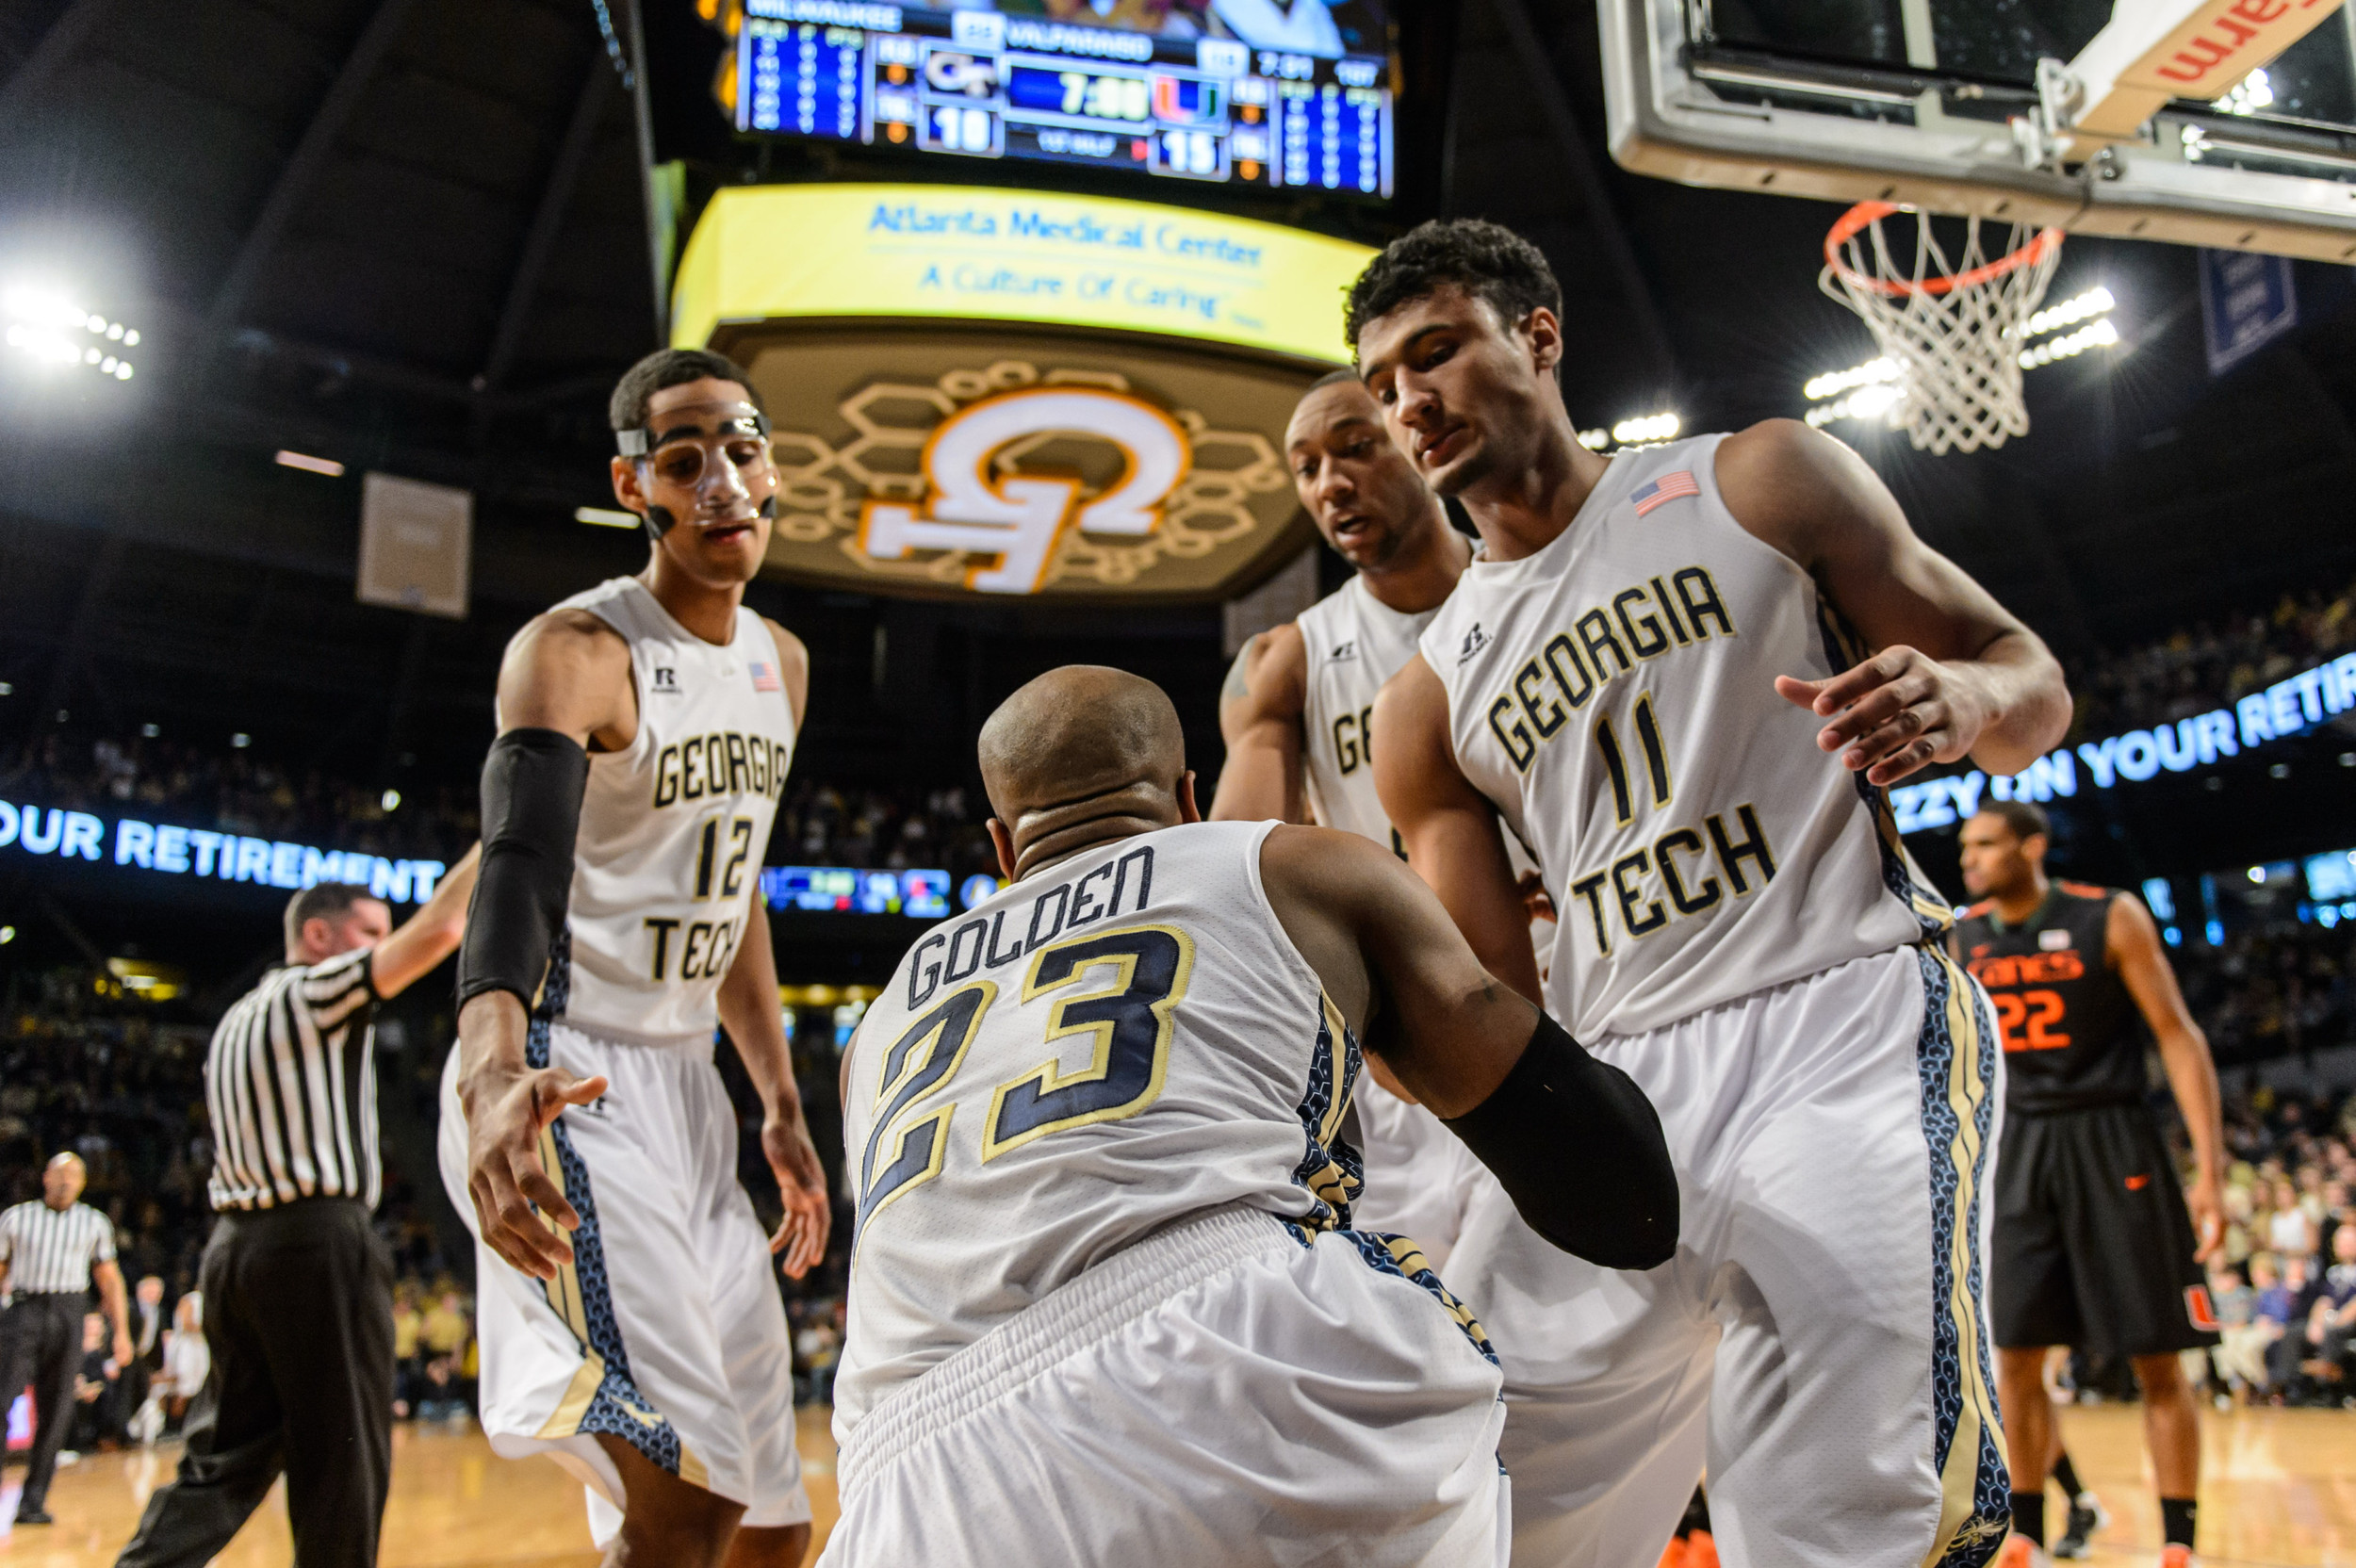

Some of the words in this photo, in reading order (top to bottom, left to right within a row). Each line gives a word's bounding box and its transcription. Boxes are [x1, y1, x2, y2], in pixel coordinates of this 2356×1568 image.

[2155, 0, 2318, 83] arm
[868, 204, 997, 236] Atlanta
[1009, 209, 1144, 250] Medical
[1156, 222, 1263, 268] Center
[920, 265, 941, 290] A
[953, 264, 1063, 297] Culture
[1077, 273, 1115, 301] Of
[1124, 279, 1219, 319] Caring
[1489, 566, 1736, 776] GEORGIA
[653, 730, 788, 809] GEORGIA
[1594, 690, 1675, 830] 11
[2077, 709, 2239, 790] YOUR
[114, 818, 446, 906] RETIREMENT
[693, 814, 753, 903] 12
[1571, 803, 1778, 958] TECH
[908, 845, 1154, 1012] GOLDEN
[1990, 989, 2071, 1054] 22
[851, 923, 1195, 1267] 23
